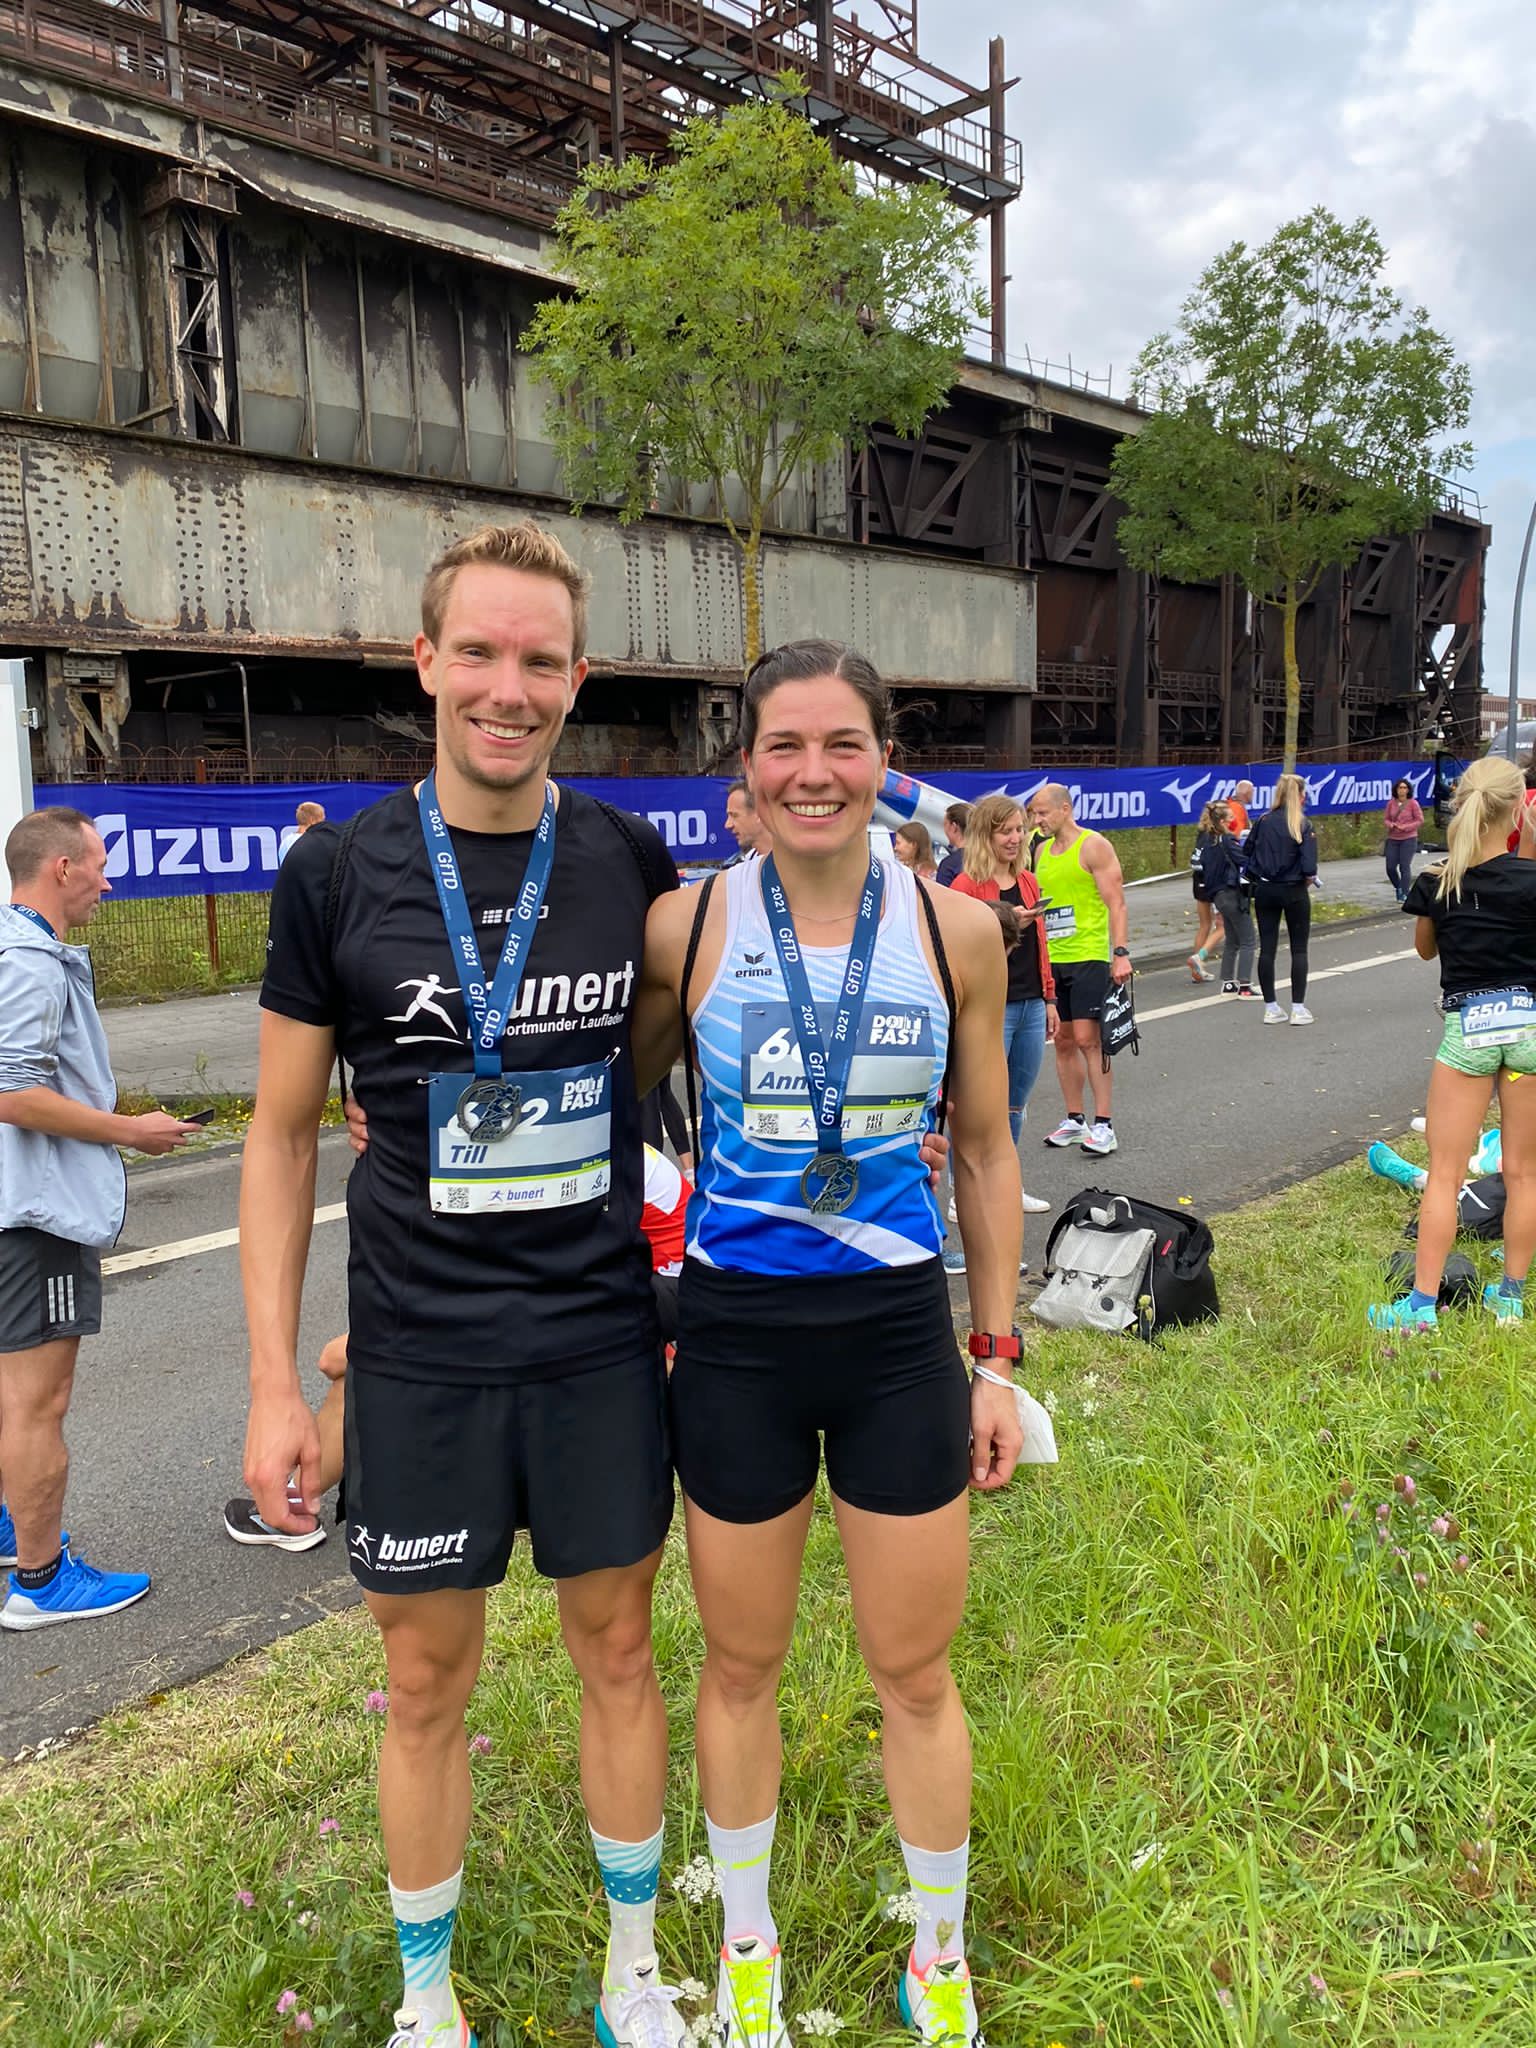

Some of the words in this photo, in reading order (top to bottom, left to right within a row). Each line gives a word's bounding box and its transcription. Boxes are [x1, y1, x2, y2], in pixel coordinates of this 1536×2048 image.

[428, 808, 445, 839] 2021
[538, 812, 551, 843] 2021
[93, 812, 299, 878] IZUN
[437, 852, 458, 890] GfTD
[518, 881, 538, 921] GfTD
[771, 886, 787, 914] 2021
[861, 890, 875, 919] 2021
[460, 935, 478, 967] 2021
[503, 933, 521, 965] 2021
[779, 927, 799, 962] GfTD
[735, 967, 773, 979] erima
[846, 959, 864, 996] GfTD
[482, 961, 635, 1019] unert
[801, 1005, 817, 1036] 2021
[835, 1009, 850, 1041] 2021
[1468, 1001, 1508, 1020] 550
[480, 1009, 502, 1049] GfTD
[502, 1018, 577, 1037] ortmunder
[869, 1028, 921, 1046] FAST
[447, 1098, 549, 1137] 62
[560, 1090, 602, 1113] FAST
[821, 1086, 839, 1126] GfTD
[450, 1144, 489, 1164] Till
[507, 1187, 545, 1200] bunert
[378, 1529, 469, 1562] bunert
